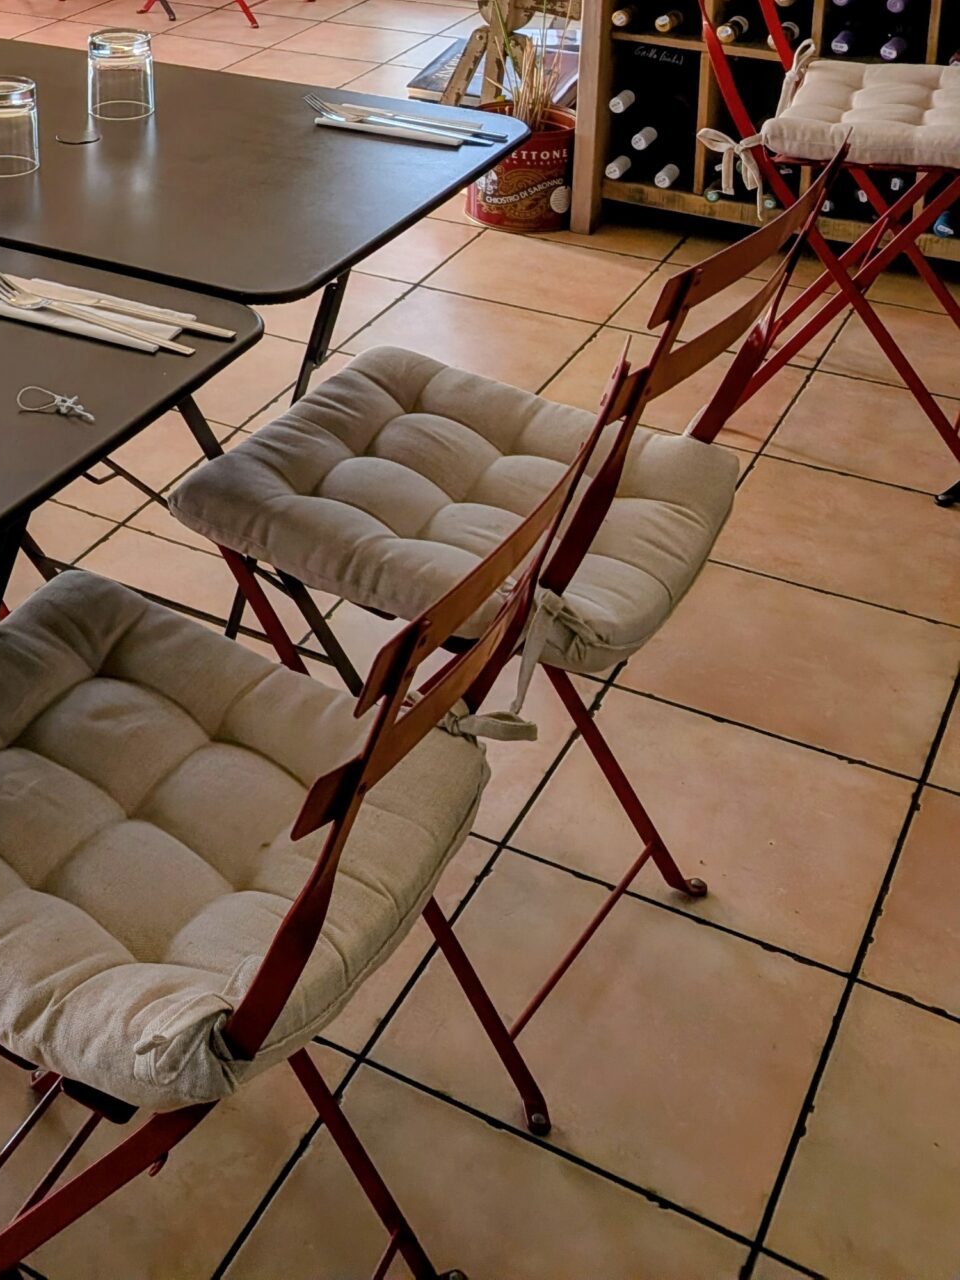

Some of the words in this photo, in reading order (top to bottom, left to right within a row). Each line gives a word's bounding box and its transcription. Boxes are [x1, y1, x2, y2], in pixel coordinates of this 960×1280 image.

[486, 194, 519, 204] CHIOSTRO
[520, 190, 527, 199] DI
[527, 178, 564, 195] SARONNO
